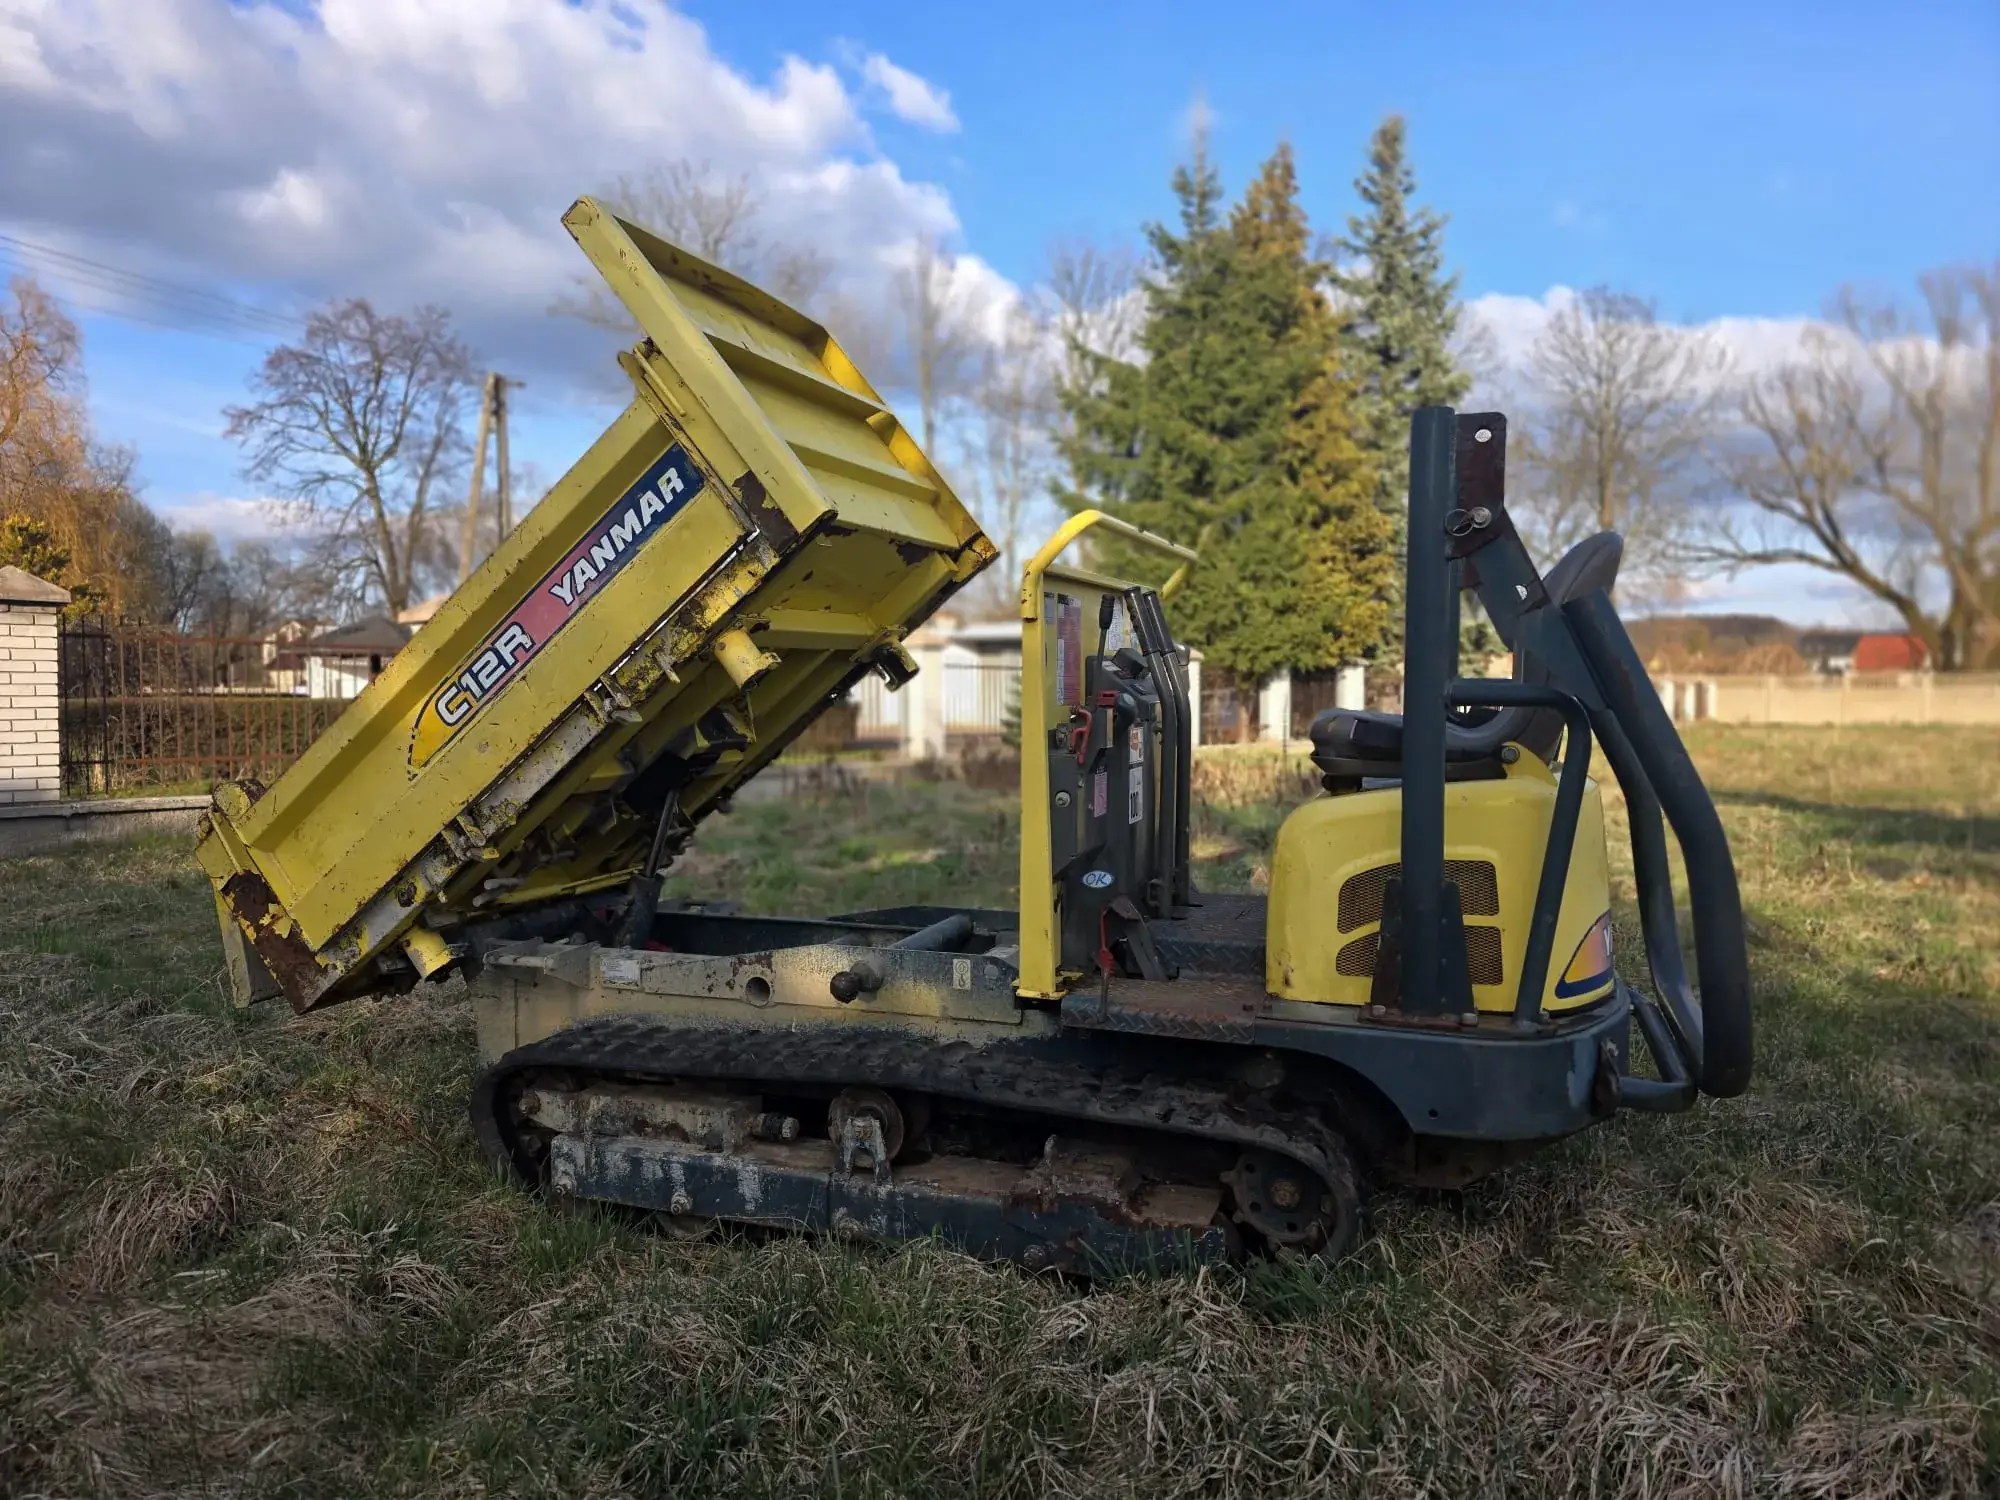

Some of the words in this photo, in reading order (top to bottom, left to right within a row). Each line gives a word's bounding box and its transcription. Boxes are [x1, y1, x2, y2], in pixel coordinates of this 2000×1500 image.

[436, 623, 534, 725] C12R
[550, 467, 685, 606] YANMAR
[1085, 872, 1108, 886] OK
